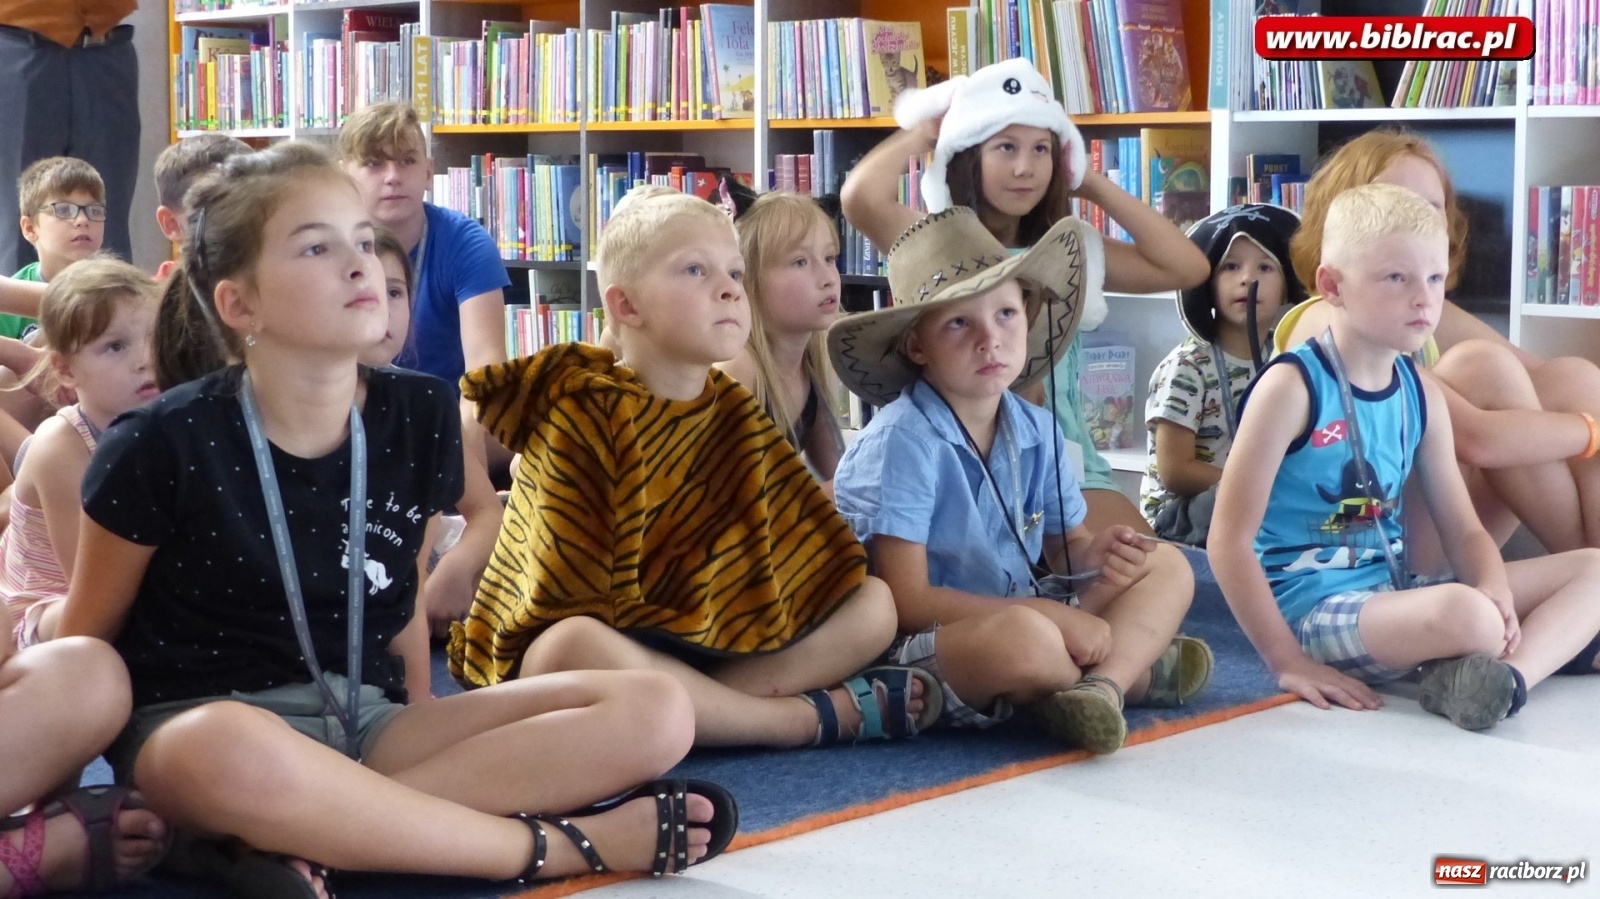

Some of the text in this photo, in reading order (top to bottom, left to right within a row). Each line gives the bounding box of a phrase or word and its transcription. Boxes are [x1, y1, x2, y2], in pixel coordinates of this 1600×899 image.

[724, 34, 750, 50] Tola
[950, 16, 958, 56] JĘZYKU
[1216, 11, 1224, 87] KOMIKSY
[417, 43, 428, 76] LAT
[340, 495, 422, 524] Te to be
[341, 523, 349, 534] a
[364, 521, 403, 547] nicorn
